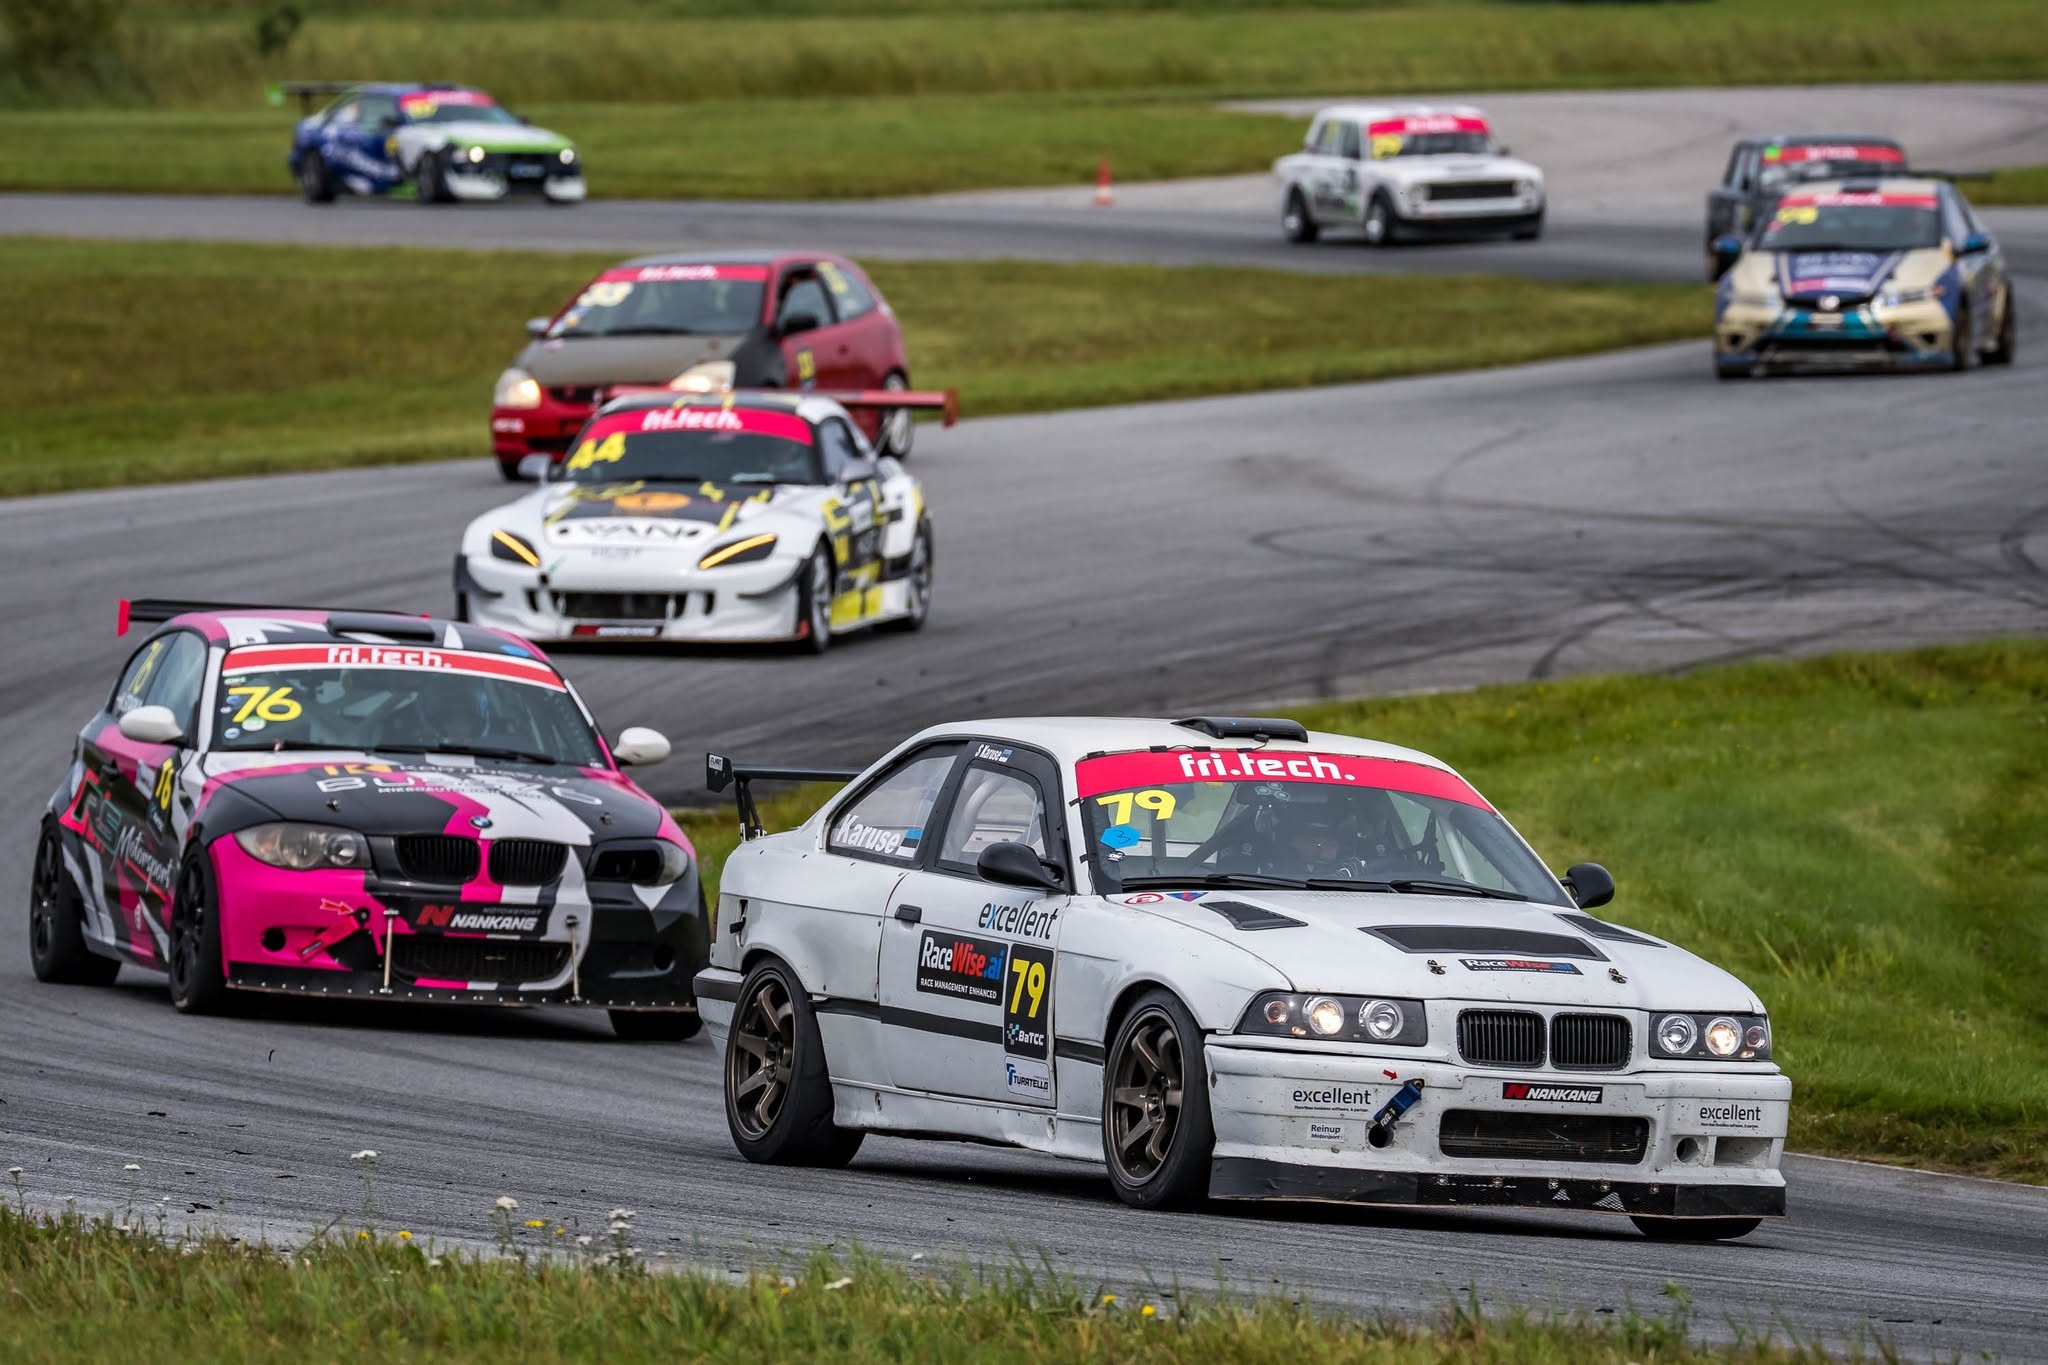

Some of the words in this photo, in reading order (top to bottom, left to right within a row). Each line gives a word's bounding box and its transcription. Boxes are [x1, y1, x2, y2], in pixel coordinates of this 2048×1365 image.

[567, 432, 626, 470] 44
[228, 685, 303, 723] 76
[979, 744, 1003, 761] Karuse
[1178, 753, 1356, 781] fri.tech.
[1096, 789, 1177, 826] 79
[835, 813, 902, 854] Karuse
[1113, 829, 1131, 845] 3
[450, 913, 539, 931] NANKANG
[978, 900, 1059, 940] excellent
[920, 936, 1005, 981] RaceWise.ai
[920, 977, 934, 988] RACE
[934, 980, 969, 994] MANAGEMENT
[969, 986, 998, 999] ENHANCED
[1010, 958, 1046, 1019] 79
[1018, 1030, 1045, 1046] BaTCC
[1293, 1087, 1372, 1105] excellent
[1526, 1088, 1601, 1102] NANKANG
[1699, 1104, 1761, 1121] excellent
[1311, 1124, 1341, 1135] Reinup
